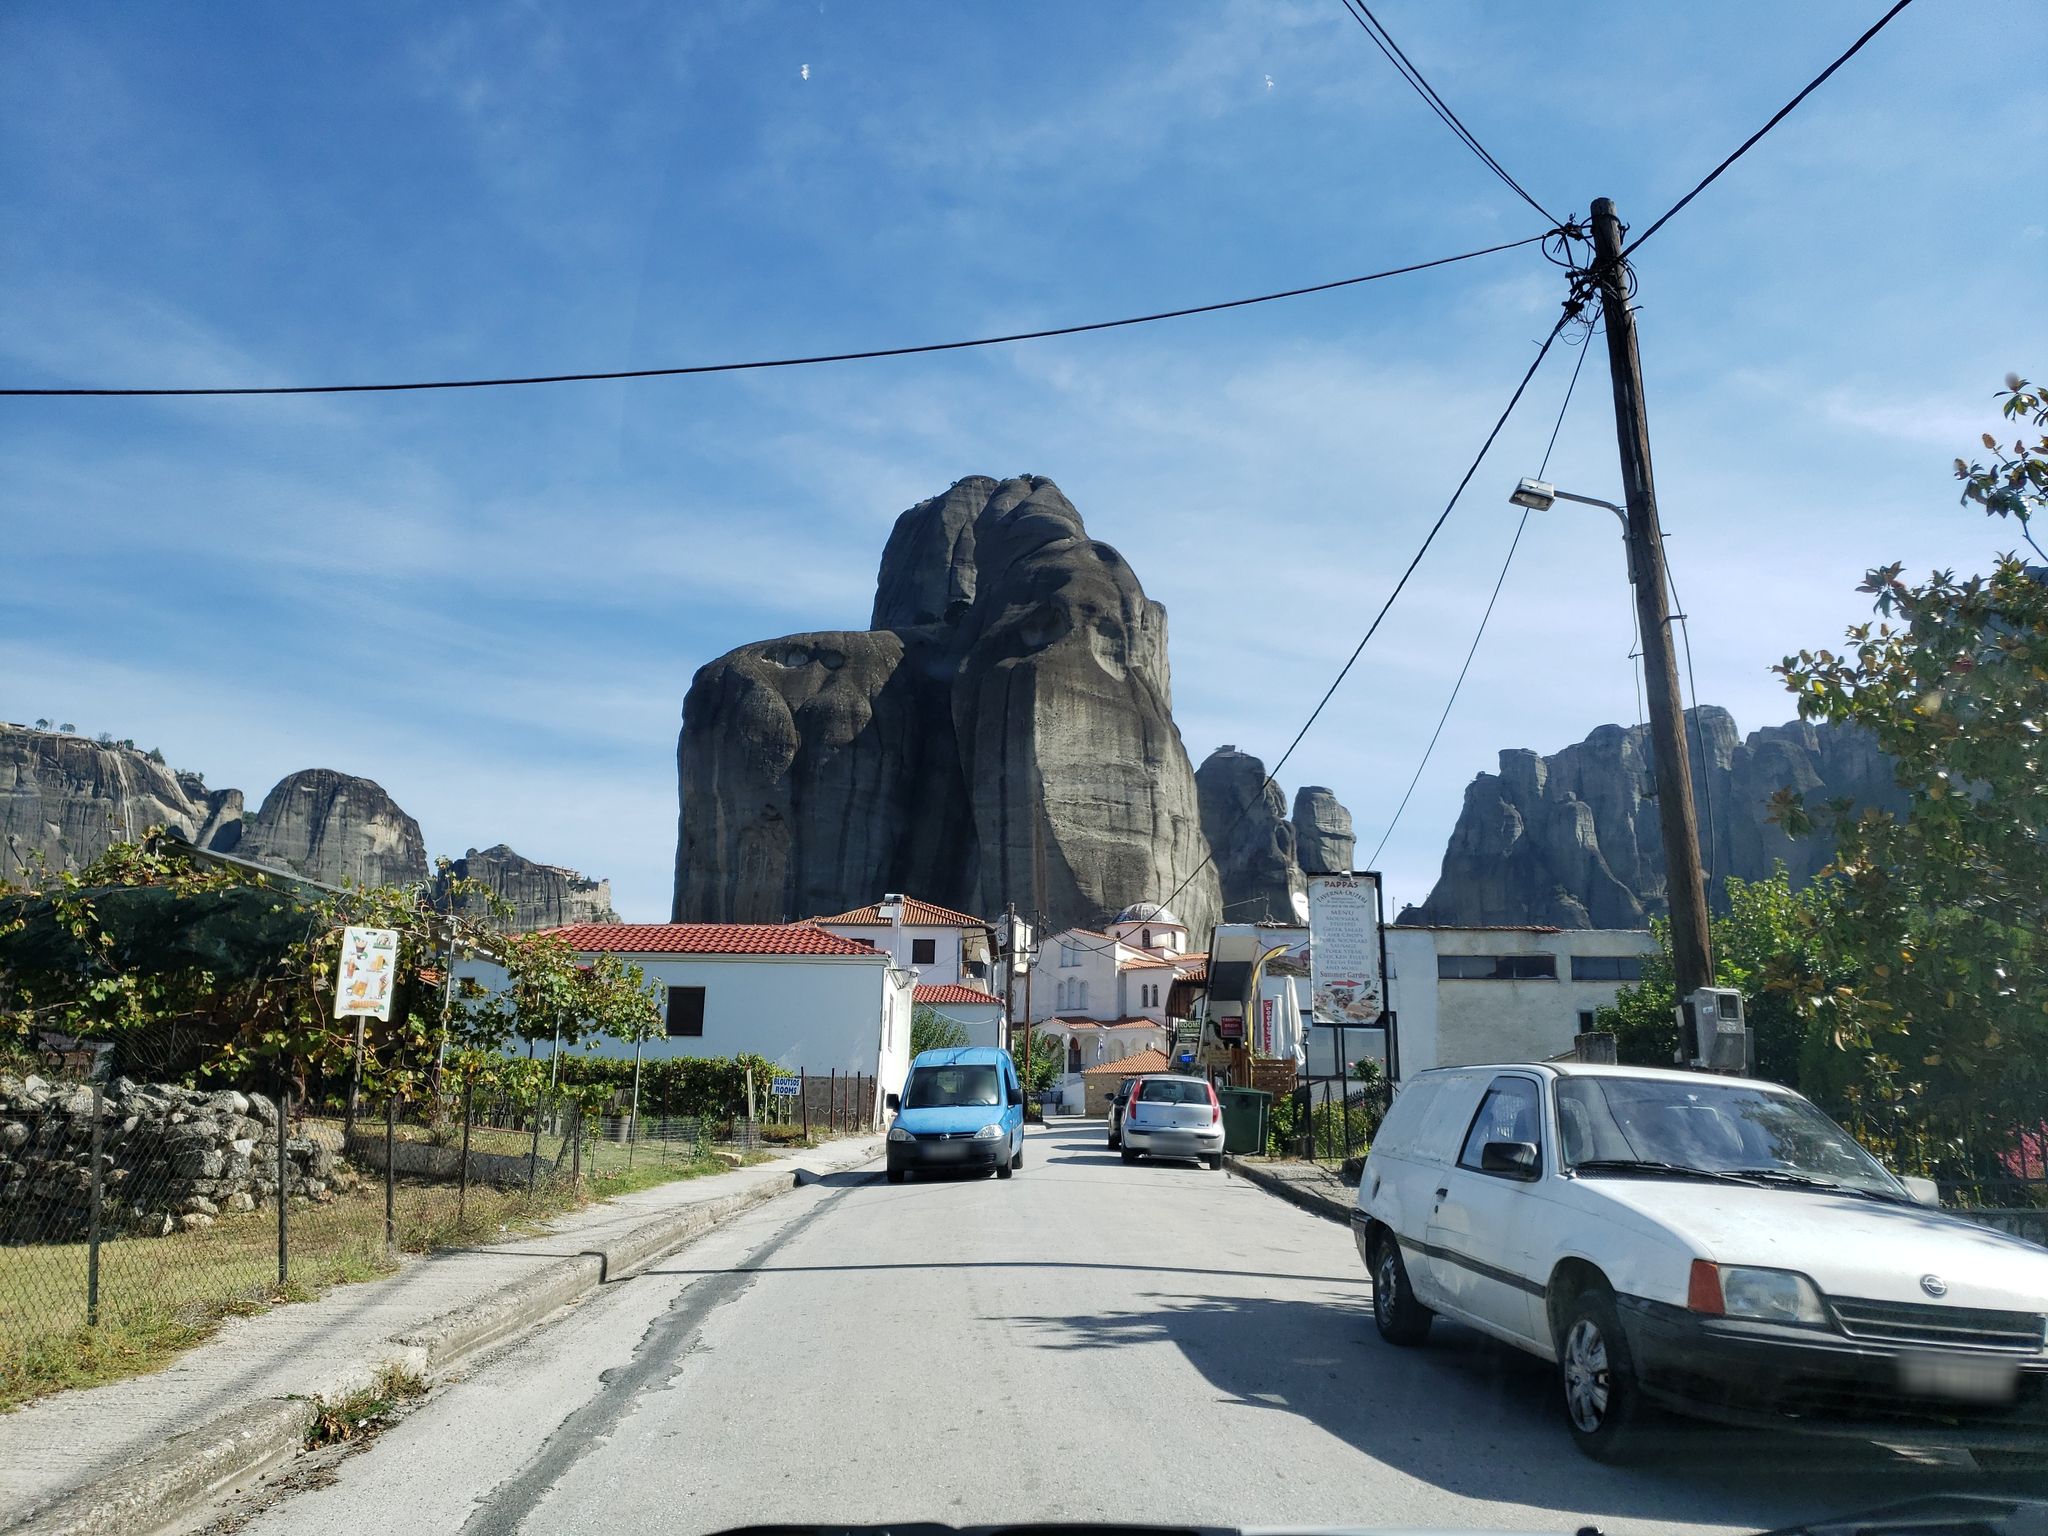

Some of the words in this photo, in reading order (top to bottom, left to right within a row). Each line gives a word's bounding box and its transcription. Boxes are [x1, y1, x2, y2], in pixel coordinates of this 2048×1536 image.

[1320, 971, 1346, 979] Summer
[774, 1078, 800, 1086] BLOUTSOS
[775, 1086, 797, 1094] ROOMS
